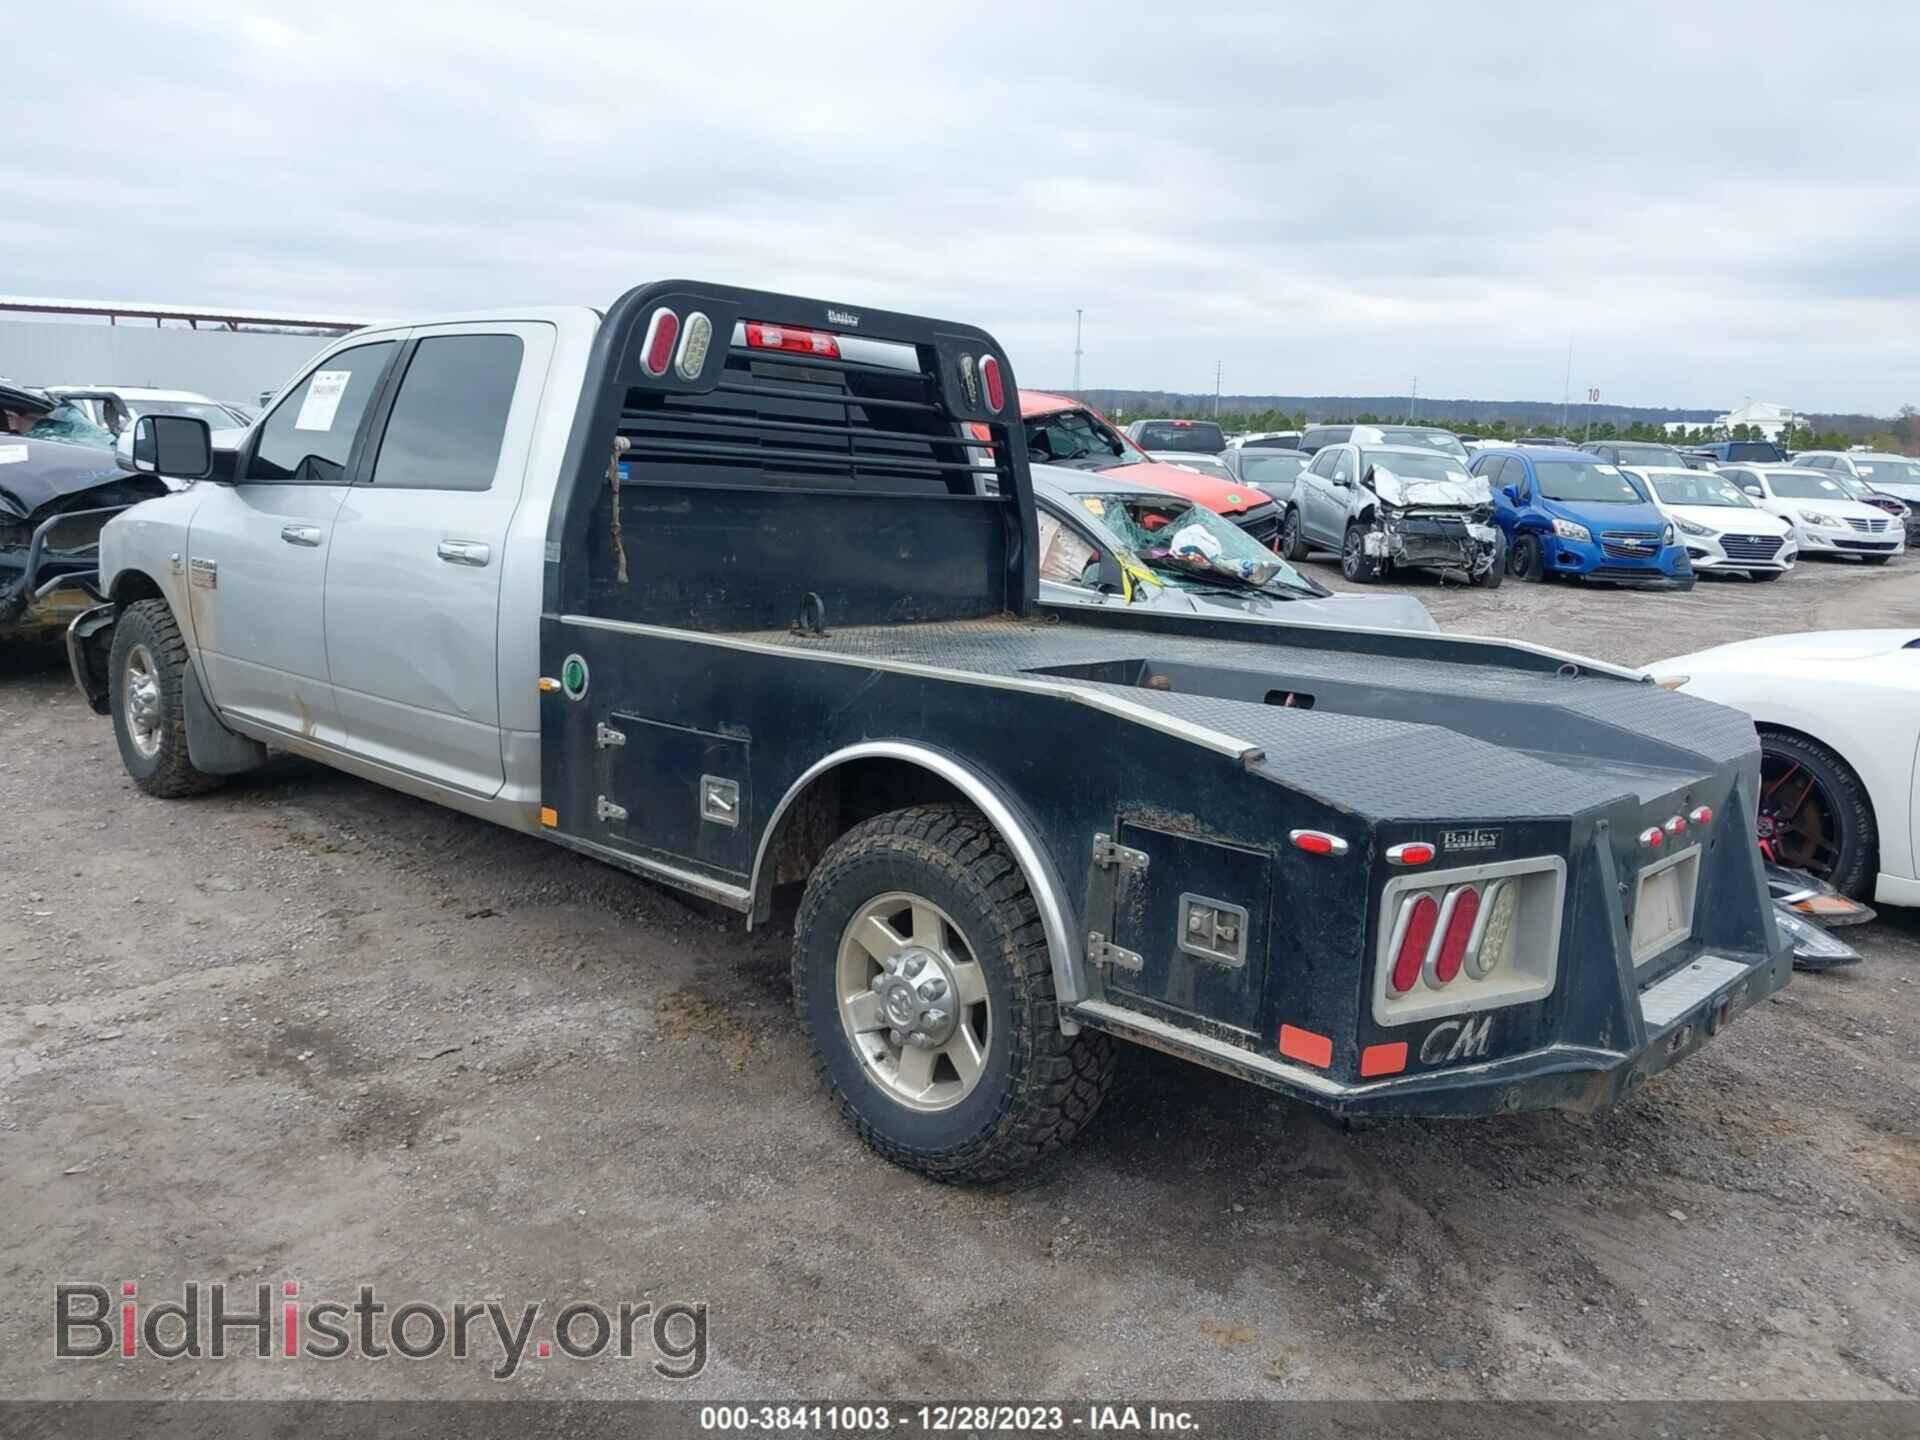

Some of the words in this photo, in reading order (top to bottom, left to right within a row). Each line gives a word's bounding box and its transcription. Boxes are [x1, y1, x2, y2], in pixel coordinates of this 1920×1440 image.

[1588, 388, 1600, 402] 10
[1444, 829, 1499, 844] Bailey
[1420, 1015, 1492, 1065] CM
